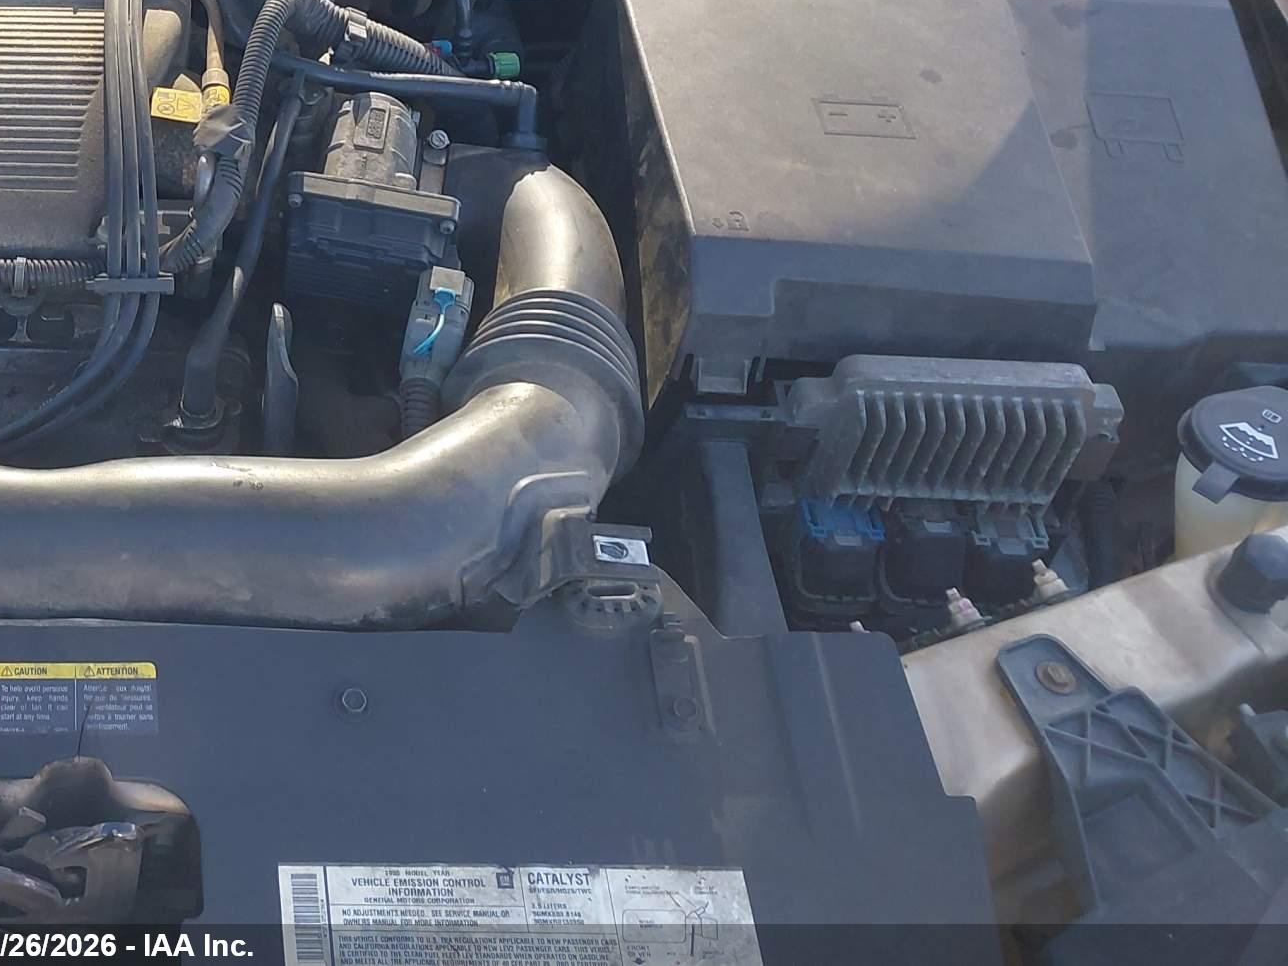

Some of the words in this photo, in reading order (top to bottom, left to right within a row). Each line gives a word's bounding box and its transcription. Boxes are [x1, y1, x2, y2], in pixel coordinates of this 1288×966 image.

[14, 666, 48, 676] CAUTION
[96, 666, 139, 676] ATTENTION
[27, 694, 42, 702] keep
[24, 714, 35, 722] any
[352, 878, 391, 887] VEHICLE
[393, 878, 439, 887] EMISSION
[443, 879, 486, 888] CONTROL
[528, 872, 590, 885] CATALYST
[388, 887, 454, 897] INFORMATION
[353, 909, 399, 917] ADJUSTMENTS
[431, 910, 442, 918] SEE
[445, 910, 471, 918] SERVICE
[472, 910, 499, 918] MANUAL
[500, 910, 510, 918] OR
[415, 919, 432, 927] MORE
[353, 935, 379, 943] VEHICLE
[417, 936, 424, 944] TO
[454, 936, 496, 945] REGULATIONS
[498, 937, 535, 945] APPLICABLE
[537, 937, 544, 945] TO
[563, 938, 599, 946] PASSENGER
[516, 945, 552, 953] PASSENGER
[339, 957, 352, 965] AND
[353, 957, 376, 965] MEETS
